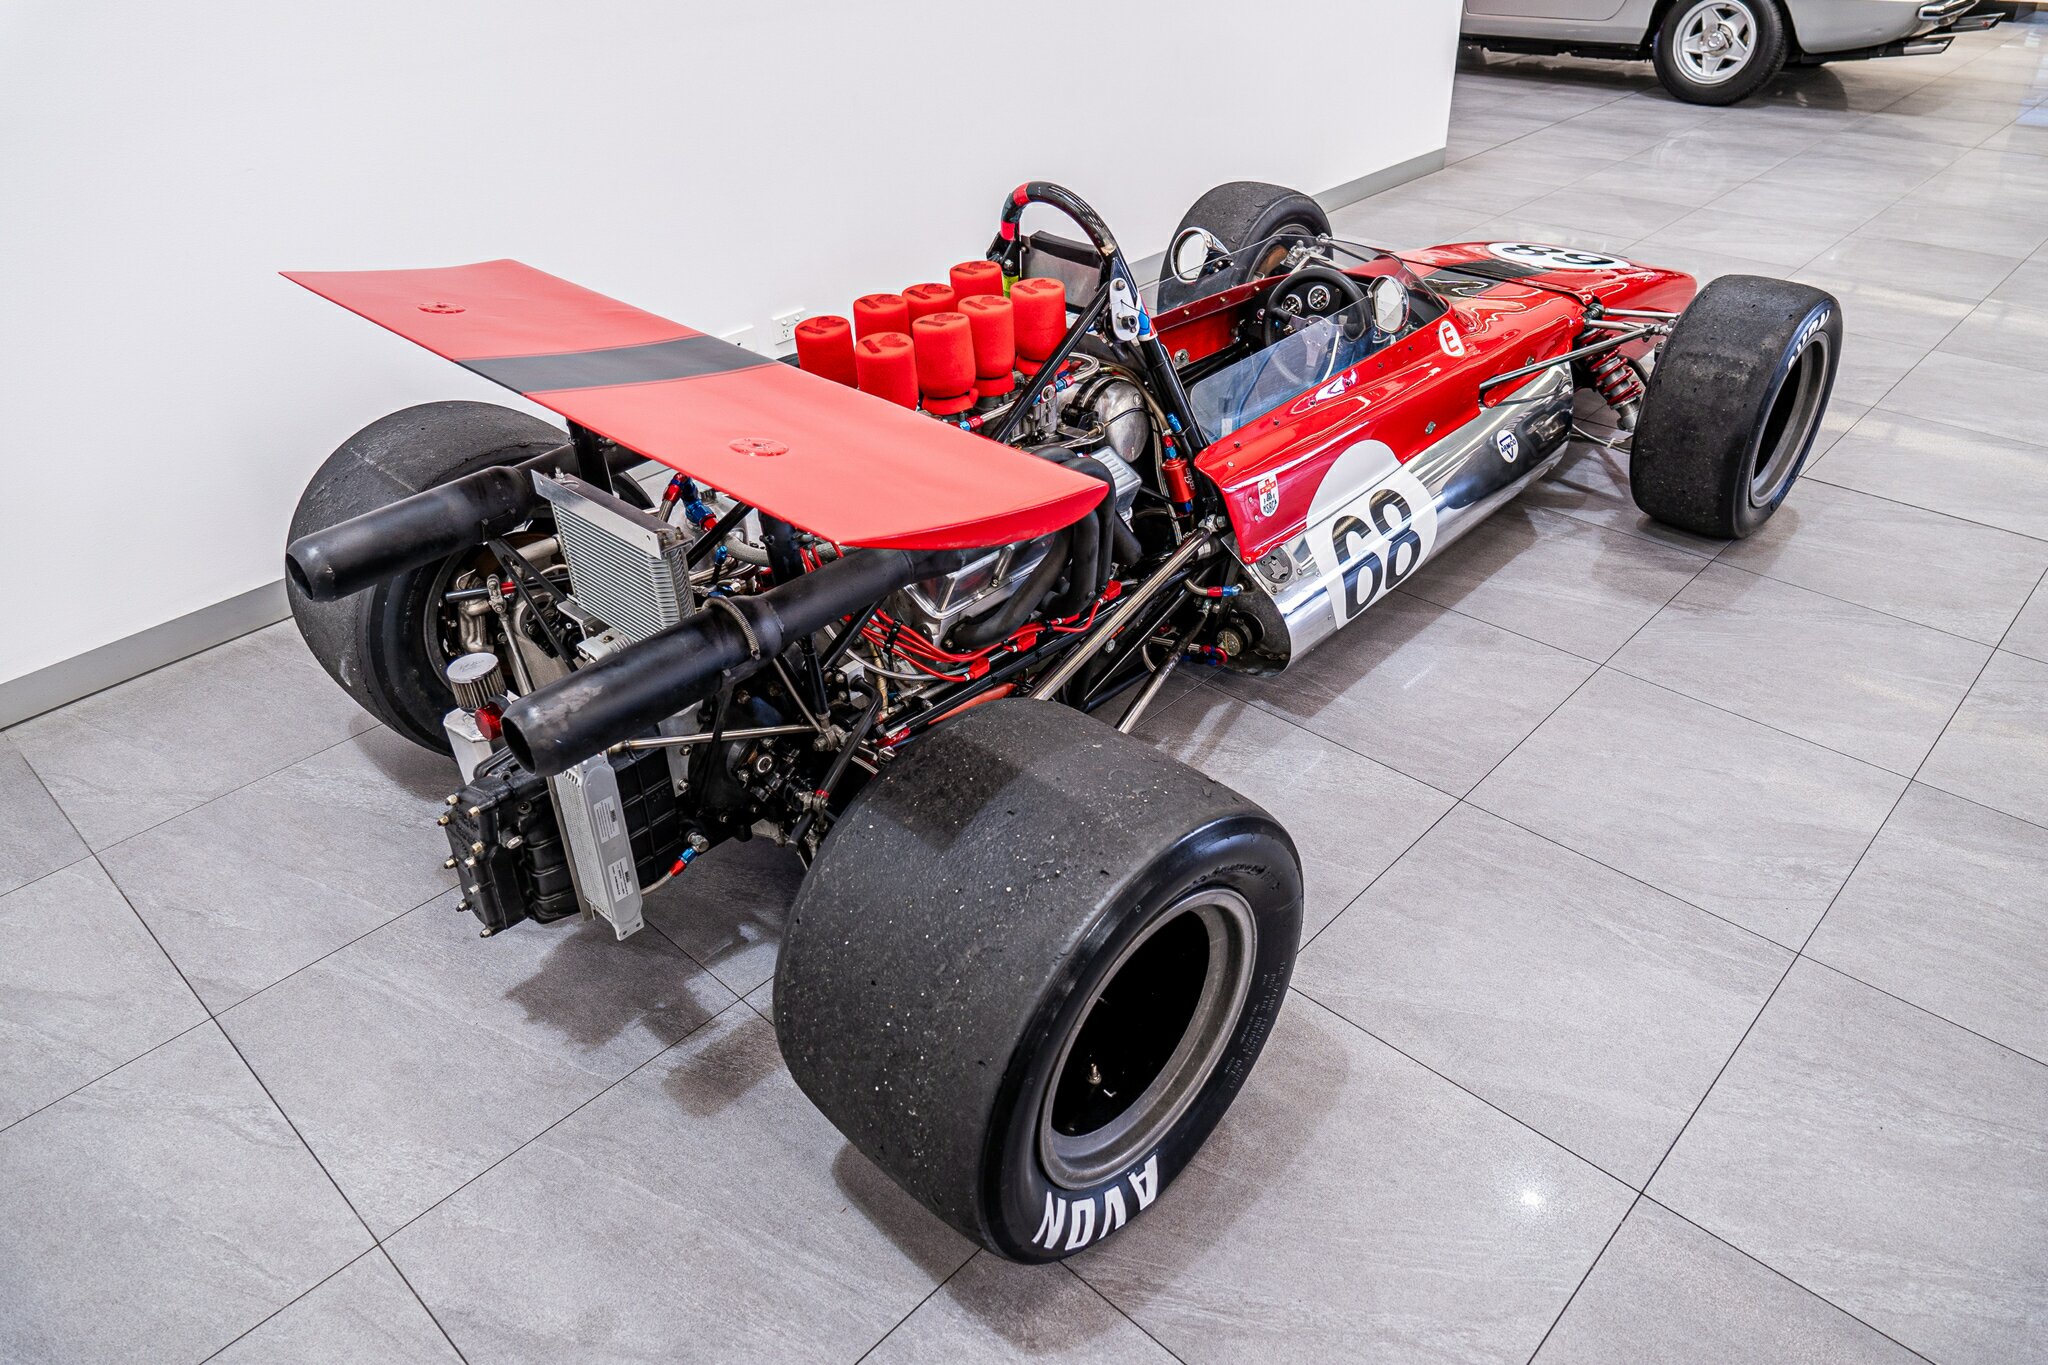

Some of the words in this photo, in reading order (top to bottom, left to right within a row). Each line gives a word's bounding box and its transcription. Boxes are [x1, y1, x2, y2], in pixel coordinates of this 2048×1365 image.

[1442, 326, 1460, 353] E
[1332, 488, 1422, 620] 68
[1031, 1154, 1159, 1251] AVON
